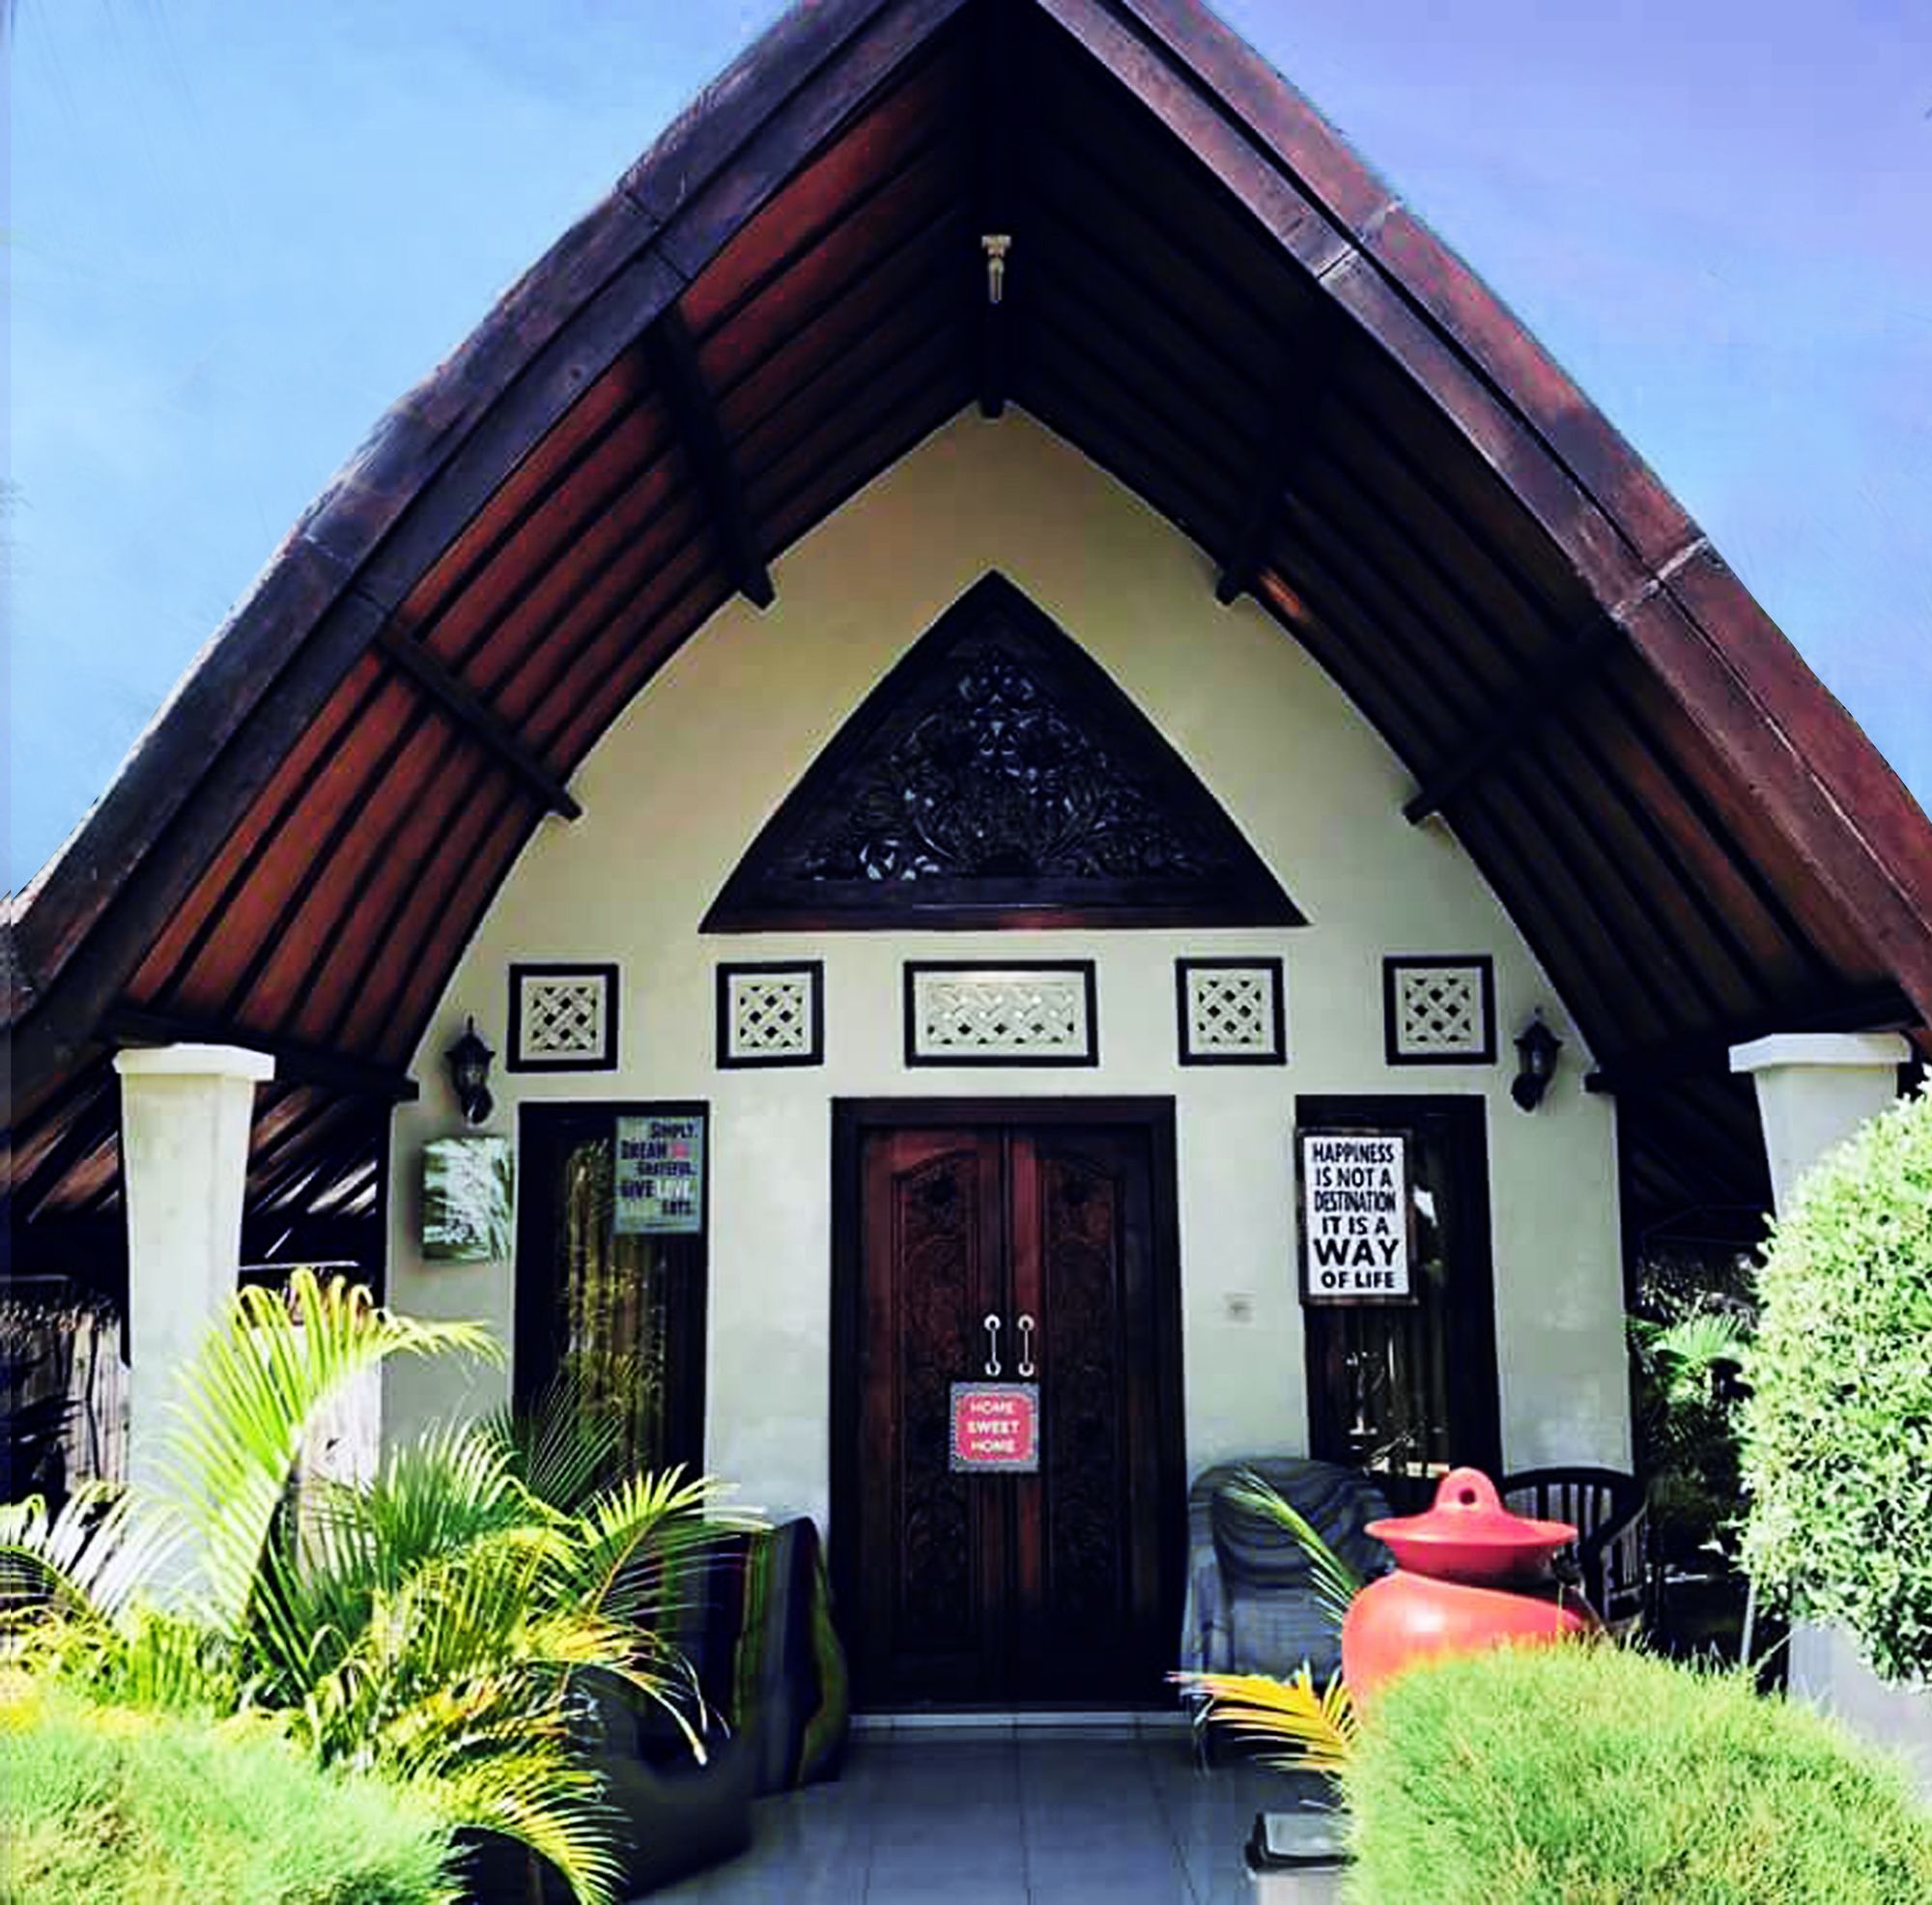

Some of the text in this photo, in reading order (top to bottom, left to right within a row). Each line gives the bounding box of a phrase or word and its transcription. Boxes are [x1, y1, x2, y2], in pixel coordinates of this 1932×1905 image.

[621, 1140, 668, 1159] DREAM
[1313, 1143, 1395, 1163] HAPPINESS
[1316, 1167, 1392, 1186] IS NOT A
[620, 1180, 655, 1198] GIVE
[1314, 1190, 1396, 1212] DESTINATION
[1322, 1216, 1389, 1235] IT IS A
[1313, 1238, 1399, 1266] WAY
[1321, 1271, 1395, 1289] OF LIFE
[970, 1399, 1013, 1414] HOME
[967, 1420, 1020, 1435] SWEET
[971, 1437, 1015, 1453] HOME
